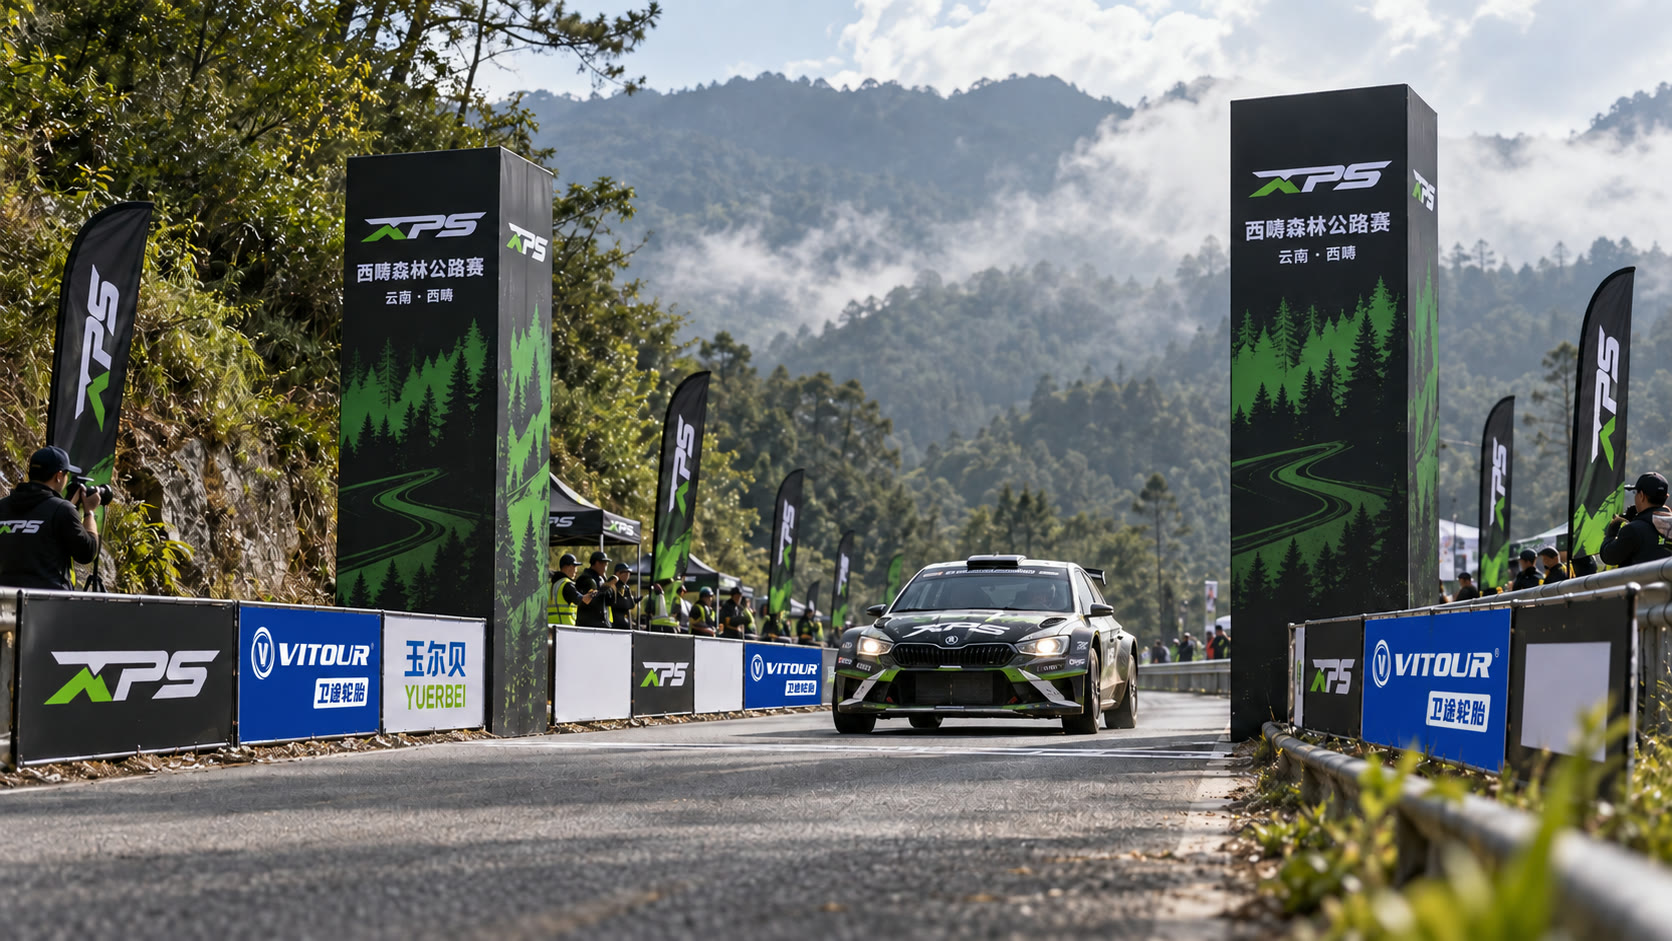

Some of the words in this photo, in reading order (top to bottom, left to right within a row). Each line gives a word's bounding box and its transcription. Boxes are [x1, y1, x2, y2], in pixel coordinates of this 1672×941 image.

[1247, 160, 1393, 198] XPS
[361, 211, 487, 243] XPS
[404, 640, 466, 677] 玉尔贝
[44, 650, 220, 706] XPS
[317, 682, 366, 704] 卫途轮胎
[405, 684, 466, 710] YUERBEI
[1430, 697, 1486, 726] 卫途轮胎
